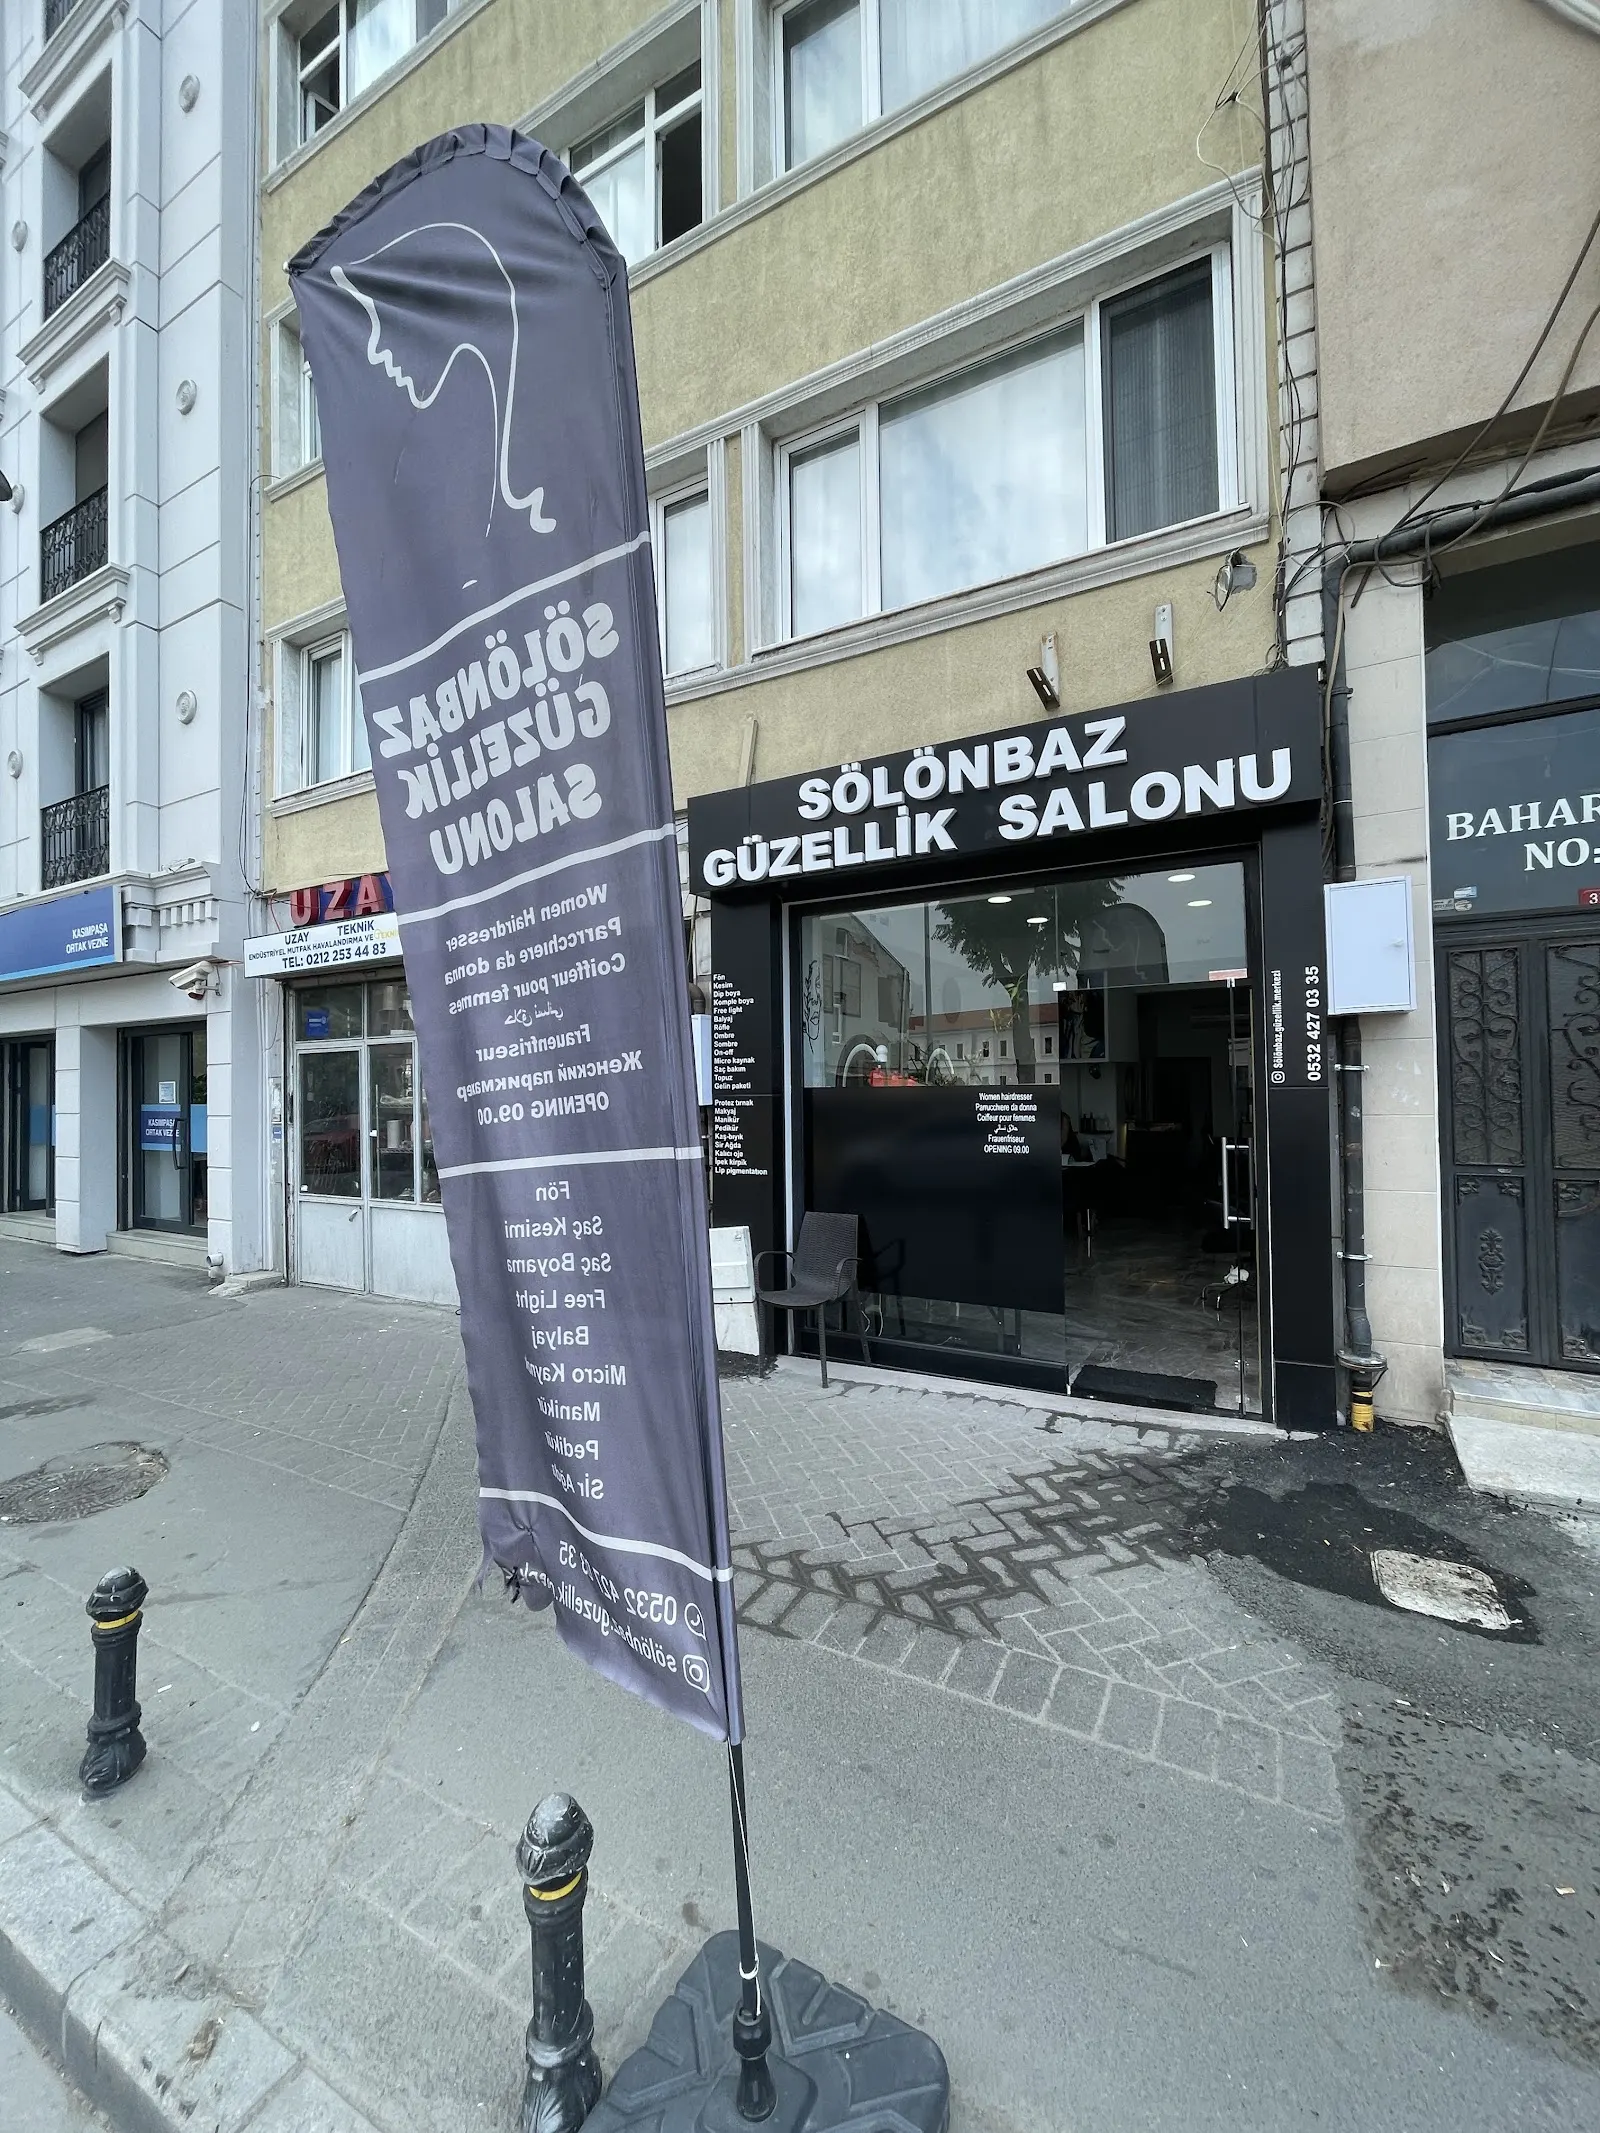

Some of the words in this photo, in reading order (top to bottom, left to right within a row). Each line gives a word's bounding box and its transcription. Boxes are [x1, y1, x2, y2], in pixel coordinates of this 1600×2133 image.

[798, 716, 1127, 822] SÖLÖNBAZ
[703, 806, 958, 887] GÜZELLİK
[999, 747, 1292, 841] SALONU
[72, 922, 109, 940] KASIMPAŞA
[285, 932, 310, 945] UZAY
[66, 940, 87, 954] ORTAK
[88, 937, 109, 950] VEZNE
[287, 943, 312, 955] MUTFAK
[313, 935, 362, 951] HAVALANDIRMA
[365, 933, 374, 942] VE
[282, 956, 303, 969] TEL:
[306, 951, 330, 965] 0212
[332, 948, 351, 962] 253
[354, 945, 369, 957] 44
[373, 942, 386, 955] 83
[1304, 965, 1319, 985] 35
[713, 982, 733, 990] Kesim
[713, 991, 725, 999] Dip
[725, 990, 741, 998] boya
[1305, 988, 1320, 1008] 03
[713, 998, 737, 1007] Komple
[738, 997, 754, 1006] boya
[728, 1006, 743, 1015] light
[713, 1015, 733, 1024] Balyaj
[1306, 1012, 1321, 1040] 427
[714, 1040, 738, 1048] Sombre
[714, 1057, 732, 1065] Micro
[732, 1056, 755, 1066] kaynak
[1307, 1043, 1322, 1082] 0532
[714, 1065, 726, 1074] Saç
[714, 1074, 733, 1083] Topuz
[714, 1082, 731, 1090] Gelin
[979, 1092, 1000, 1101] Women
[1000, 1092, 1033, 1101] hairdresser
[714, 1107, 737, 1116] Makyaj
[1010, 1103, 1018, 1111] da
[1019, 1103, 1037, 1112] donna
[976, 1113, 998, 1122] Coiffeur
[998, 1114, 1012, 1123] pour
[1012, 1113, 1036, 1122] femmes
[163, 1129, 179, 1138] VEZE
[988, 1134, 1025, 1143] Frauenfriseur
[984, 1144, 1012, 1154] OPENING
[1012, 1145, 1030, 1154] 09.00
